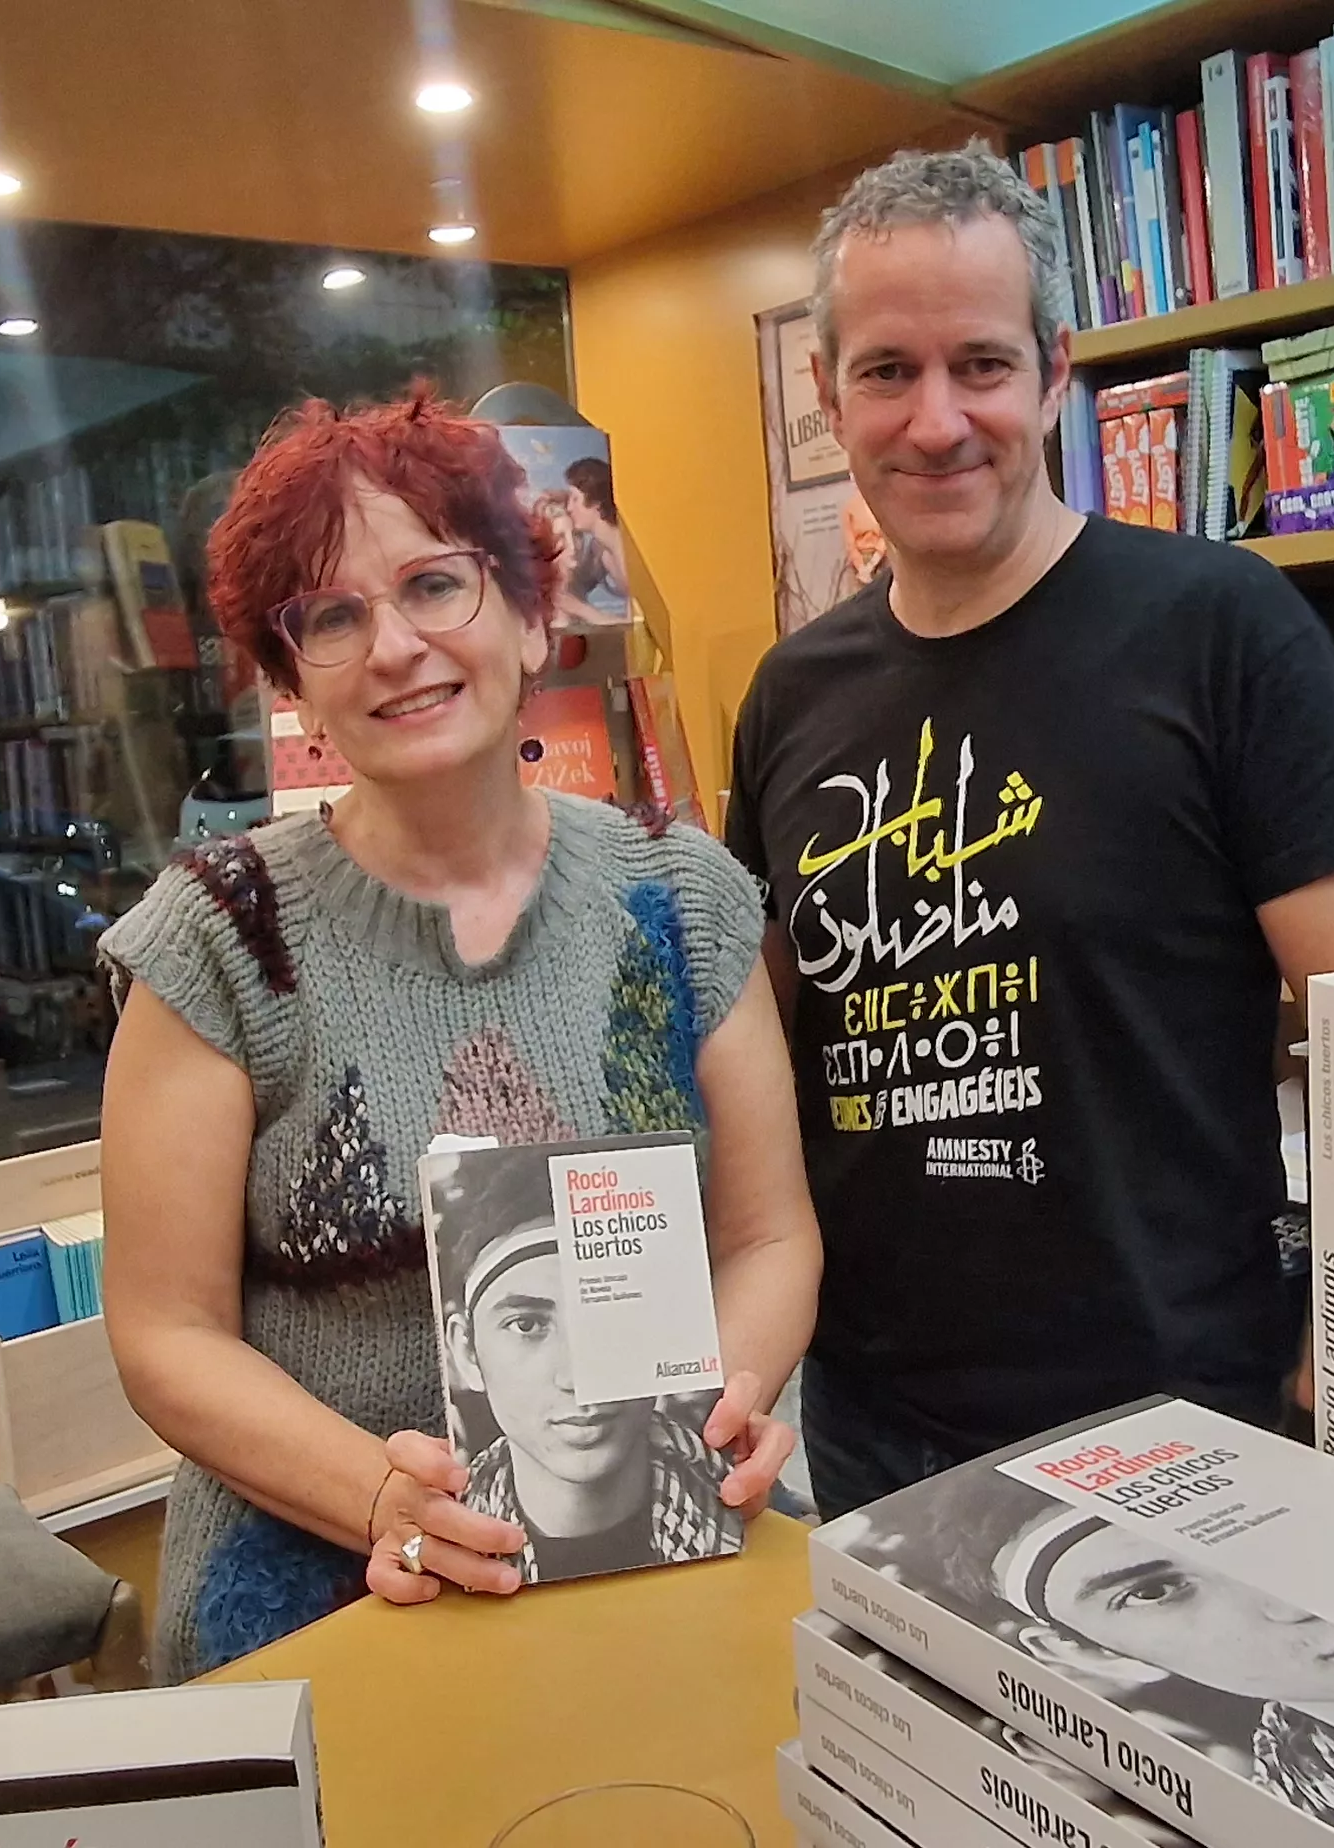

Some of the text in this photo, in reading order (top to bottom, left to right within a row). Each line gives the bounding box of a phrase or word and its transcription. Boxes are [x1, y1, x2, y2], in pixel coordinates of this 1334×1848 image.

[798, 716, 1043, 882] شباب
[891, 1066, 1043, 1127] ENGAGÉ(E)S
[926, 1137, 1013, 1161] AMNESTY
[566, 1165, 620, 1192] Rocío
[925, 1161, 1014, 1179] INTERNATIONAL
[569, 1186, 657, 1215] Lardinois
[572, 1209, 670, 1239] Los chicos
[573, 1235, 644, 1262] tuertos
[657, 1356, 720, 1378] Alianza Lit
[1035, 1442, 1121, 1479] Rocío
[1064, 1436, 1197, 1493] Lardinois
[1095, 1446, 1239, 1507] Los chicos
[1126, 1472, 1235, 1519] tuertos
[996, 1669, 1194, 1817] Rocío Lardinois
[980, 1765, 1090, 1848] Lardinois
